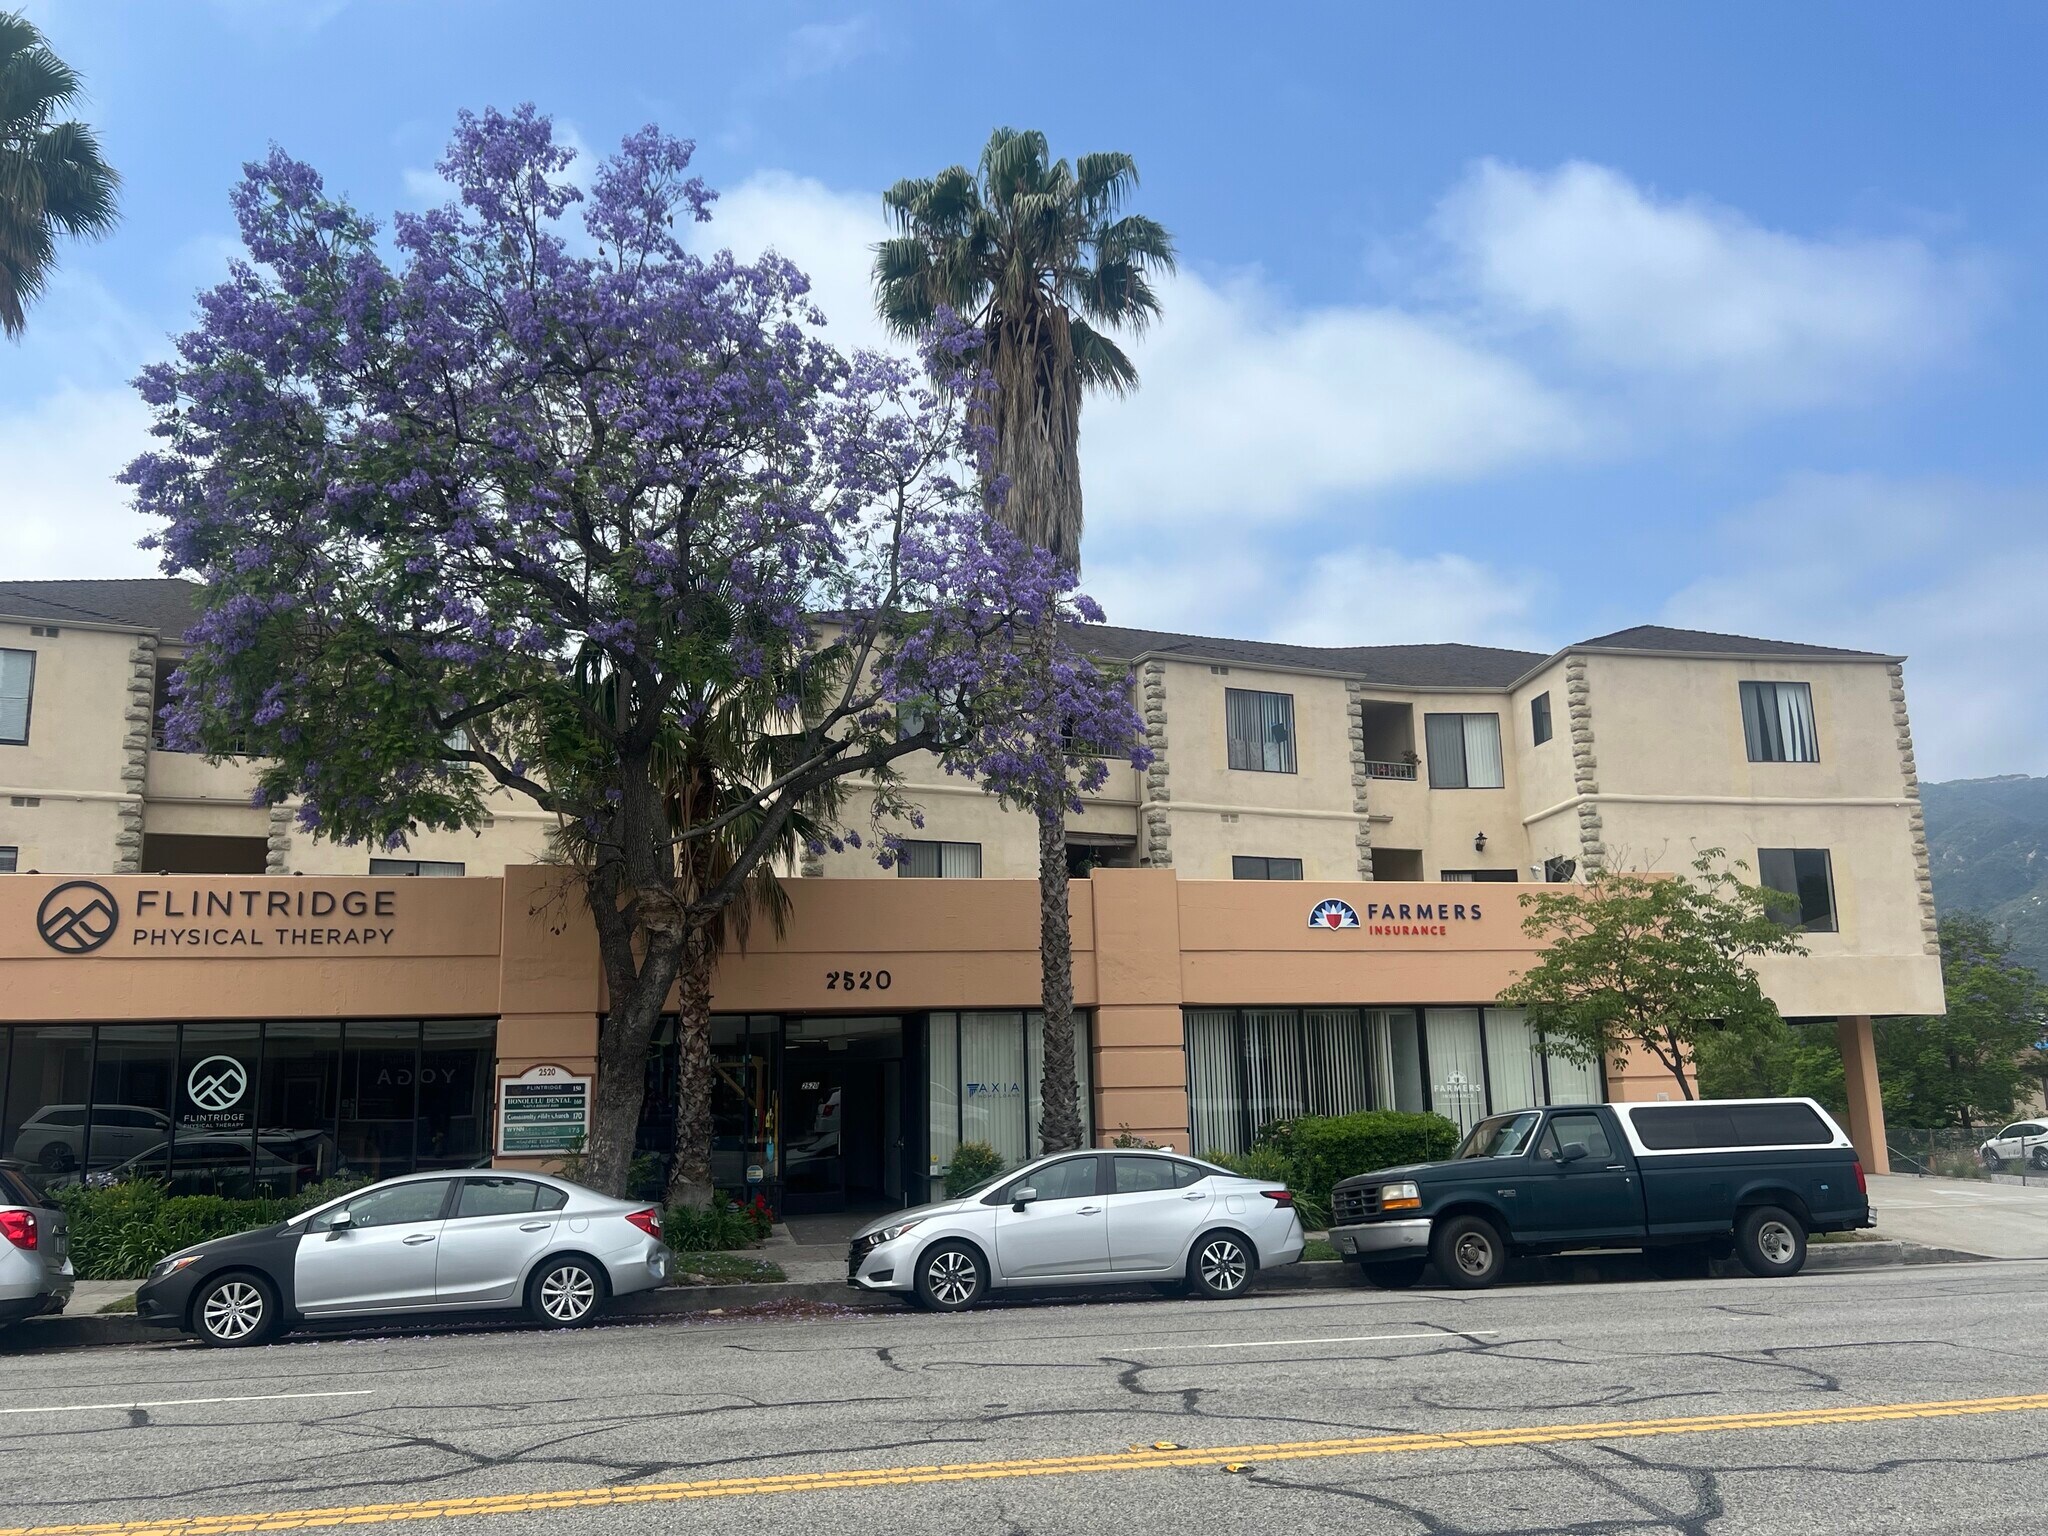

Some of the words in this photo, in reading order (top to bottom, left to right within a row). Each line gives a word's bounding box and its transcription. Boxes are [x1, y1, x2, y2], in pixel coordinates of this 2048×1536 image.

[135, 890, 395, 917] FLINTRIDGE
[1367, 903, 1483, 921] FARMERS
[1370, 925, 1447, 936] INSURANCE
[133, 929, 263, 946] PHYSICAL
[276, 928, 395, 945] THERAPY
[826, 970, 892, 991] 2520
[538, 1068, 556, 1076] 2520
[978, 1083, 1020, 1093] AXIA
[1434, 1084, 1481, 1093] FARMERS
[183, 1113, 245, 1122] FLINTRIDGE
